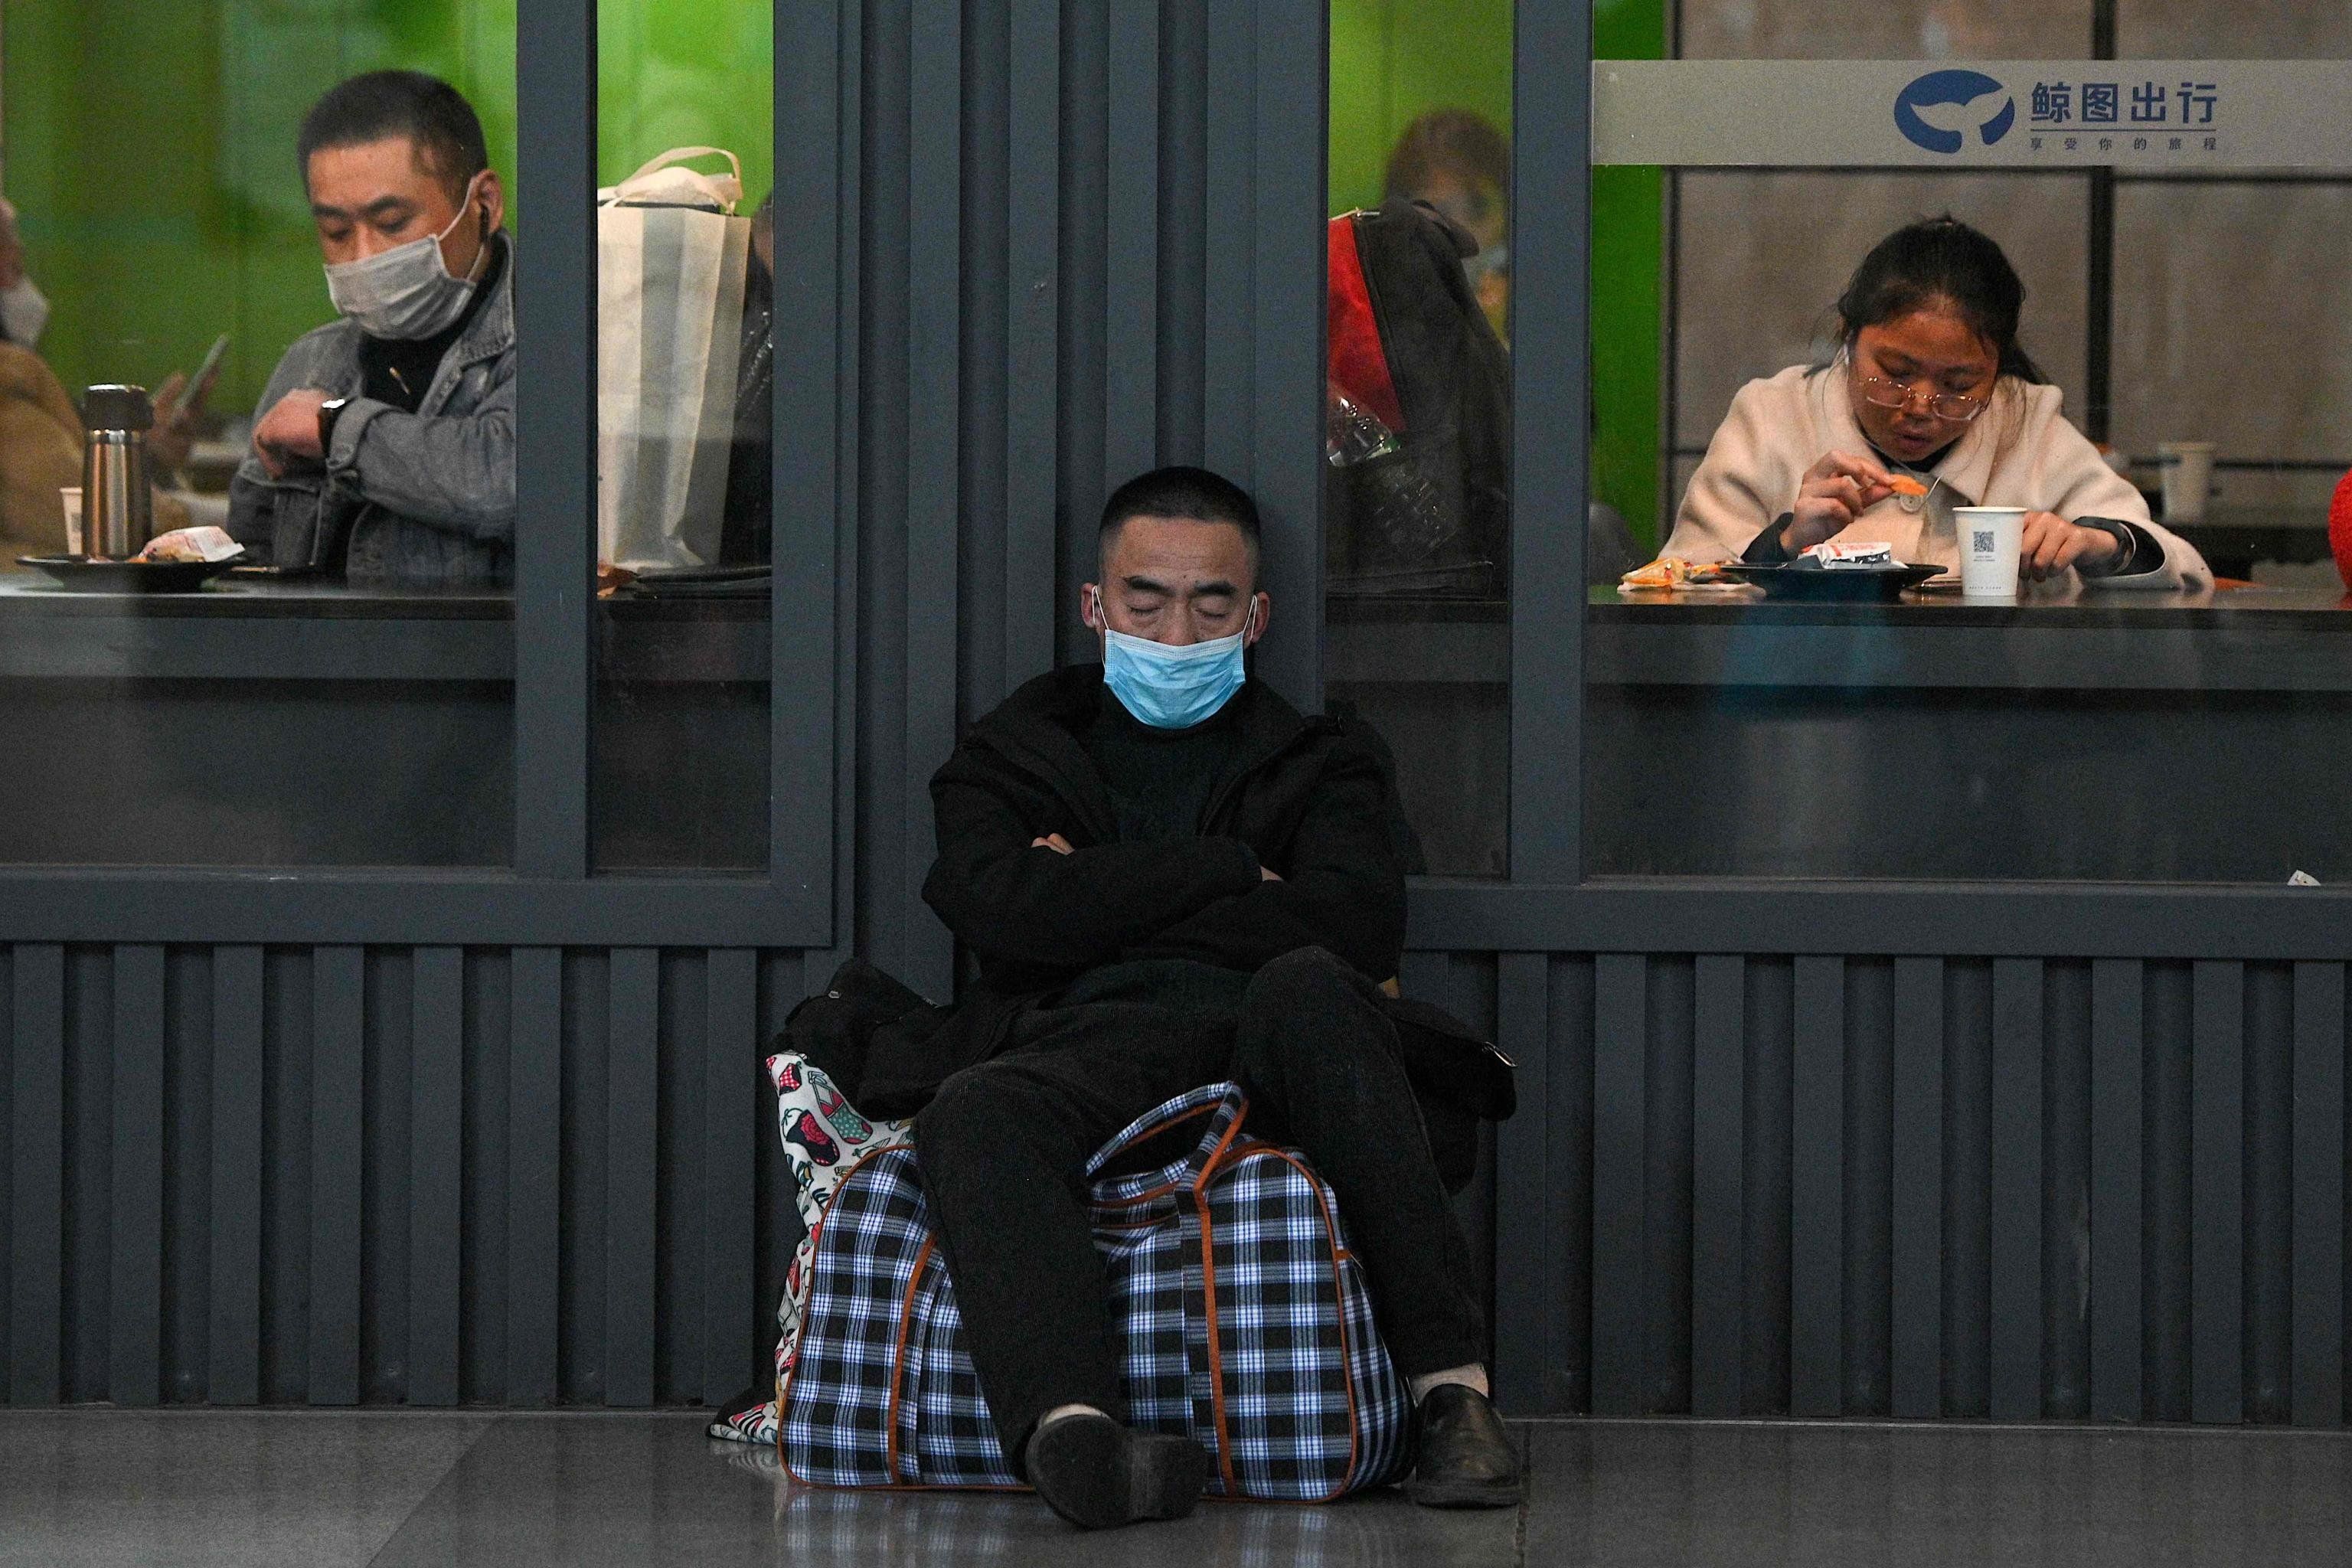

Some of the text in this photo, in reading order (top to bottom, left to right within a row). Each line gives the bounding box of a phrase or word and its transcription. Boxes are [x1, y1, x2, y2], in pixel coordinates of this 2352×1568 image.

[2030, 81, 2217, 124] 鲸图出行
[2030, 137, 2217, 151] 享受你的旅程
